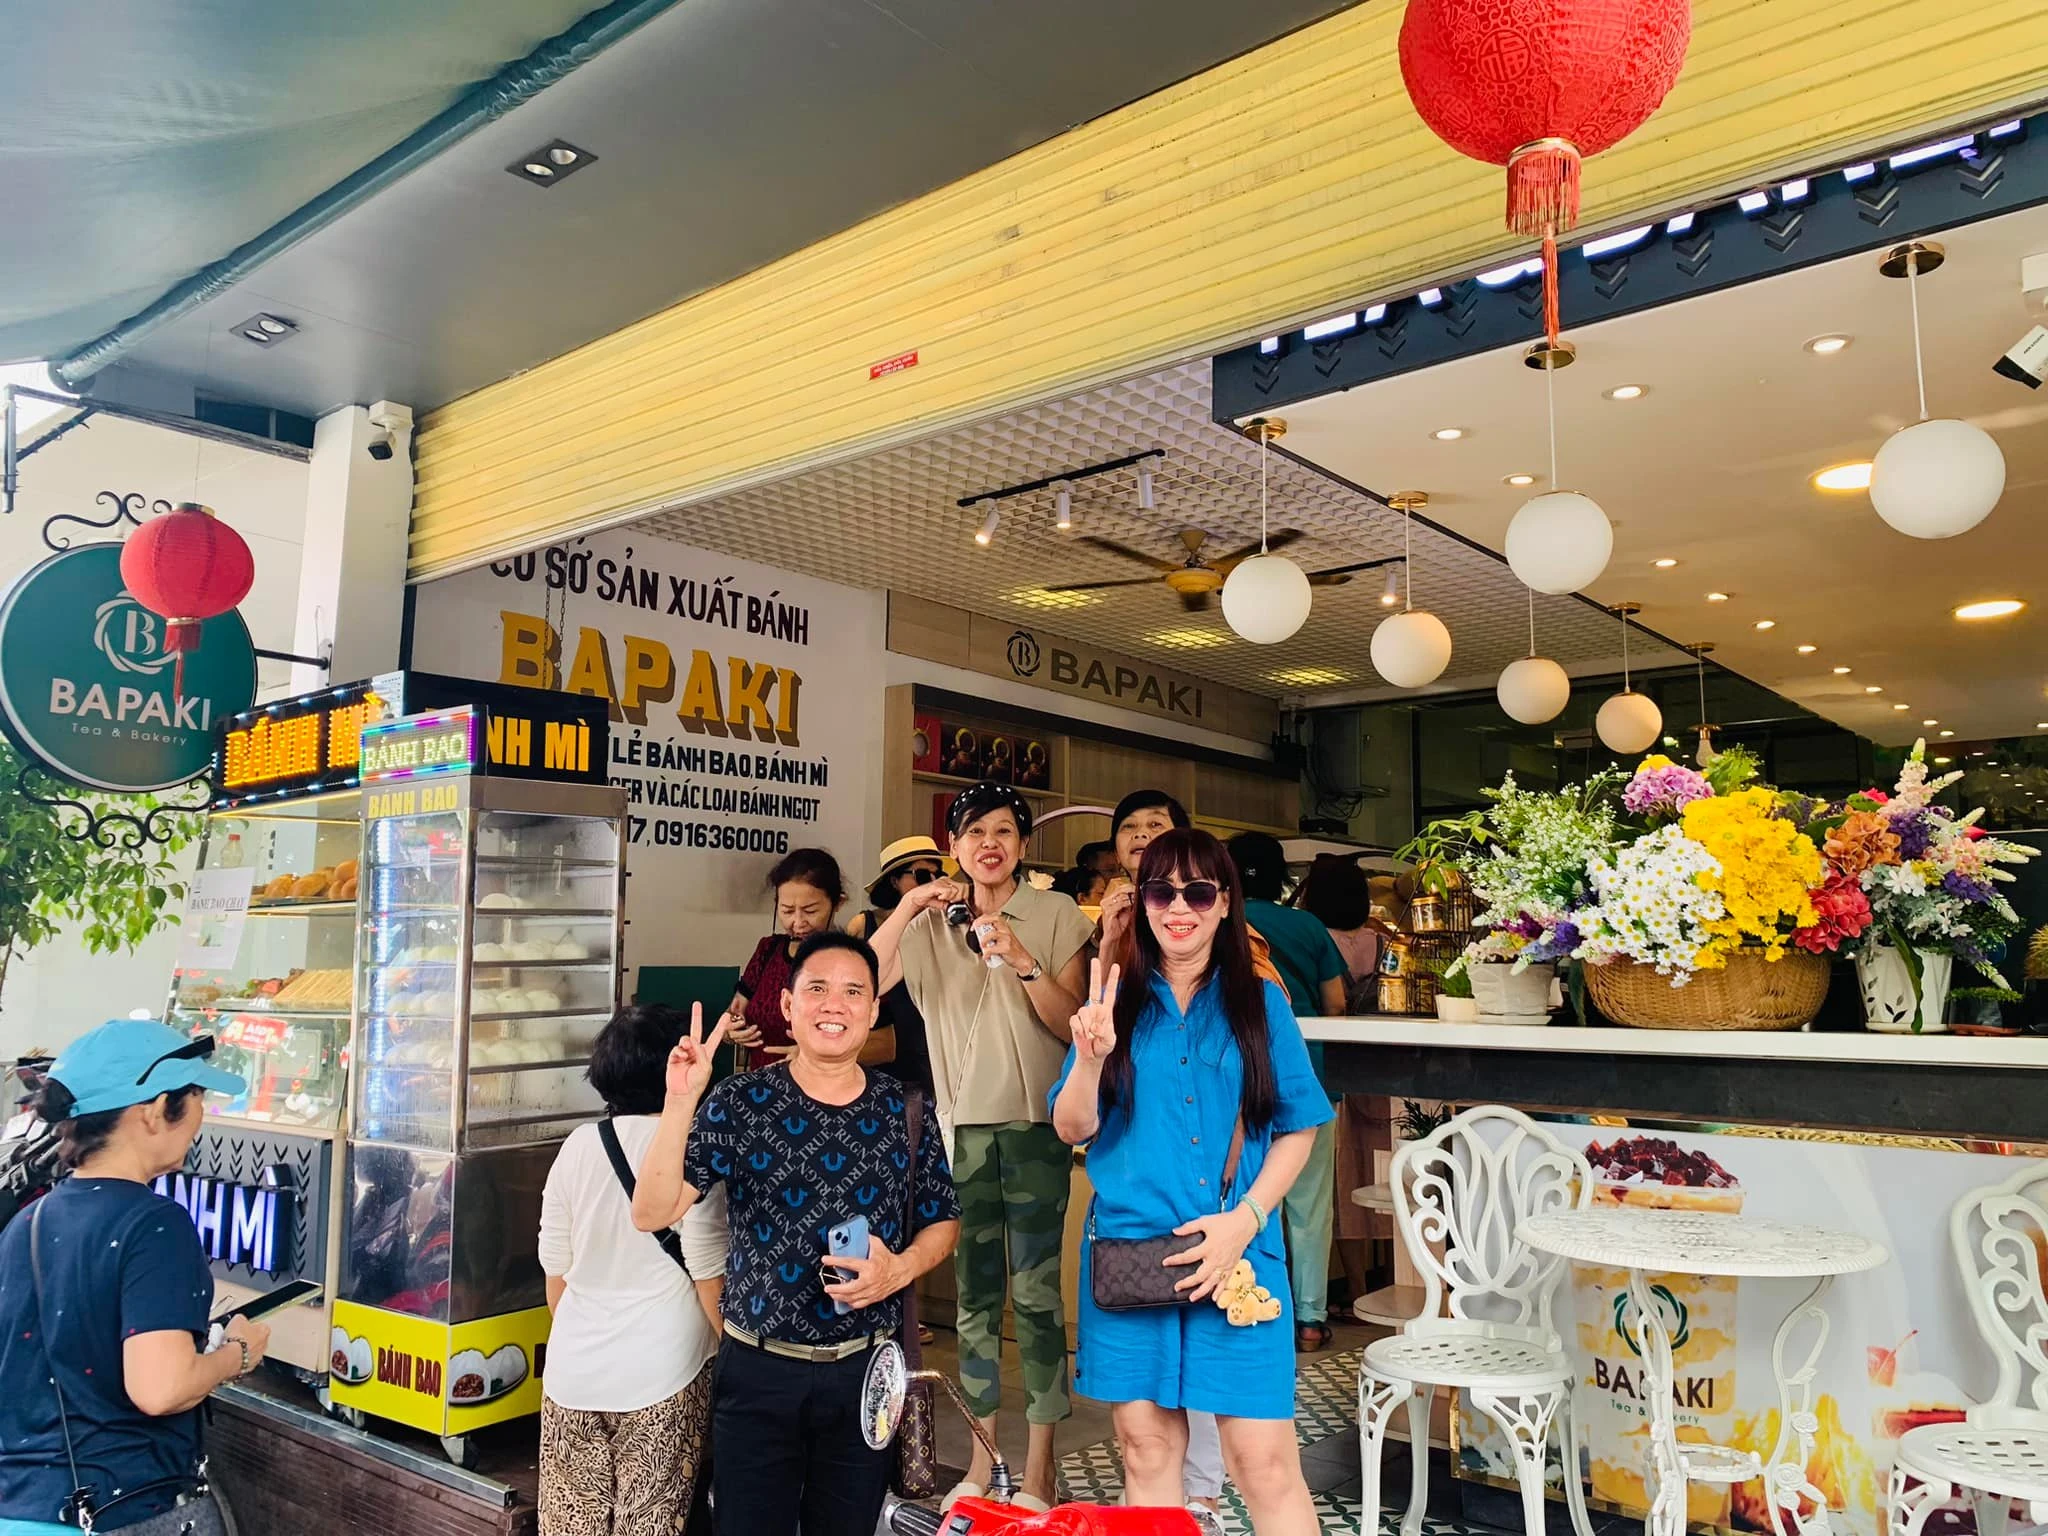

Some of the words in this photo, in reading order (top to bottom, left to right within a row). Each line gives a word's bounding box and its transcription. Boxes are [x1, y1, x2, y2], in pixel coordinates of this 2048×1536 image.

[597, 547, 659, 611] SẢN
[667, 576, 743, 629] XUẤT
[747, 590, 809, 645] BÁNH
[125, 610, 156, 655] B
[497, 611, 802, 747] BAPAKI
[1050, 648, 1204, 718] BAPAKI
[50, 678, 211, 731] BAPAKI
[71, 723, 102, 736] Tea
[112, 727, 121, 738] &
[131, 730, 187, 746] Bakery
[224, 717, 320, 786] BÁNH
[364, 736, 420, 771] BÁNH
[423, 733, 466, 764] BAO
[544, 717, 590, 772] MÌ
[612, 729, 641, 766] LẺ
[646, 737, 705, 773] BÁNH
[755, 750, 807, 785] BÁNH
[810, 756, 828, 787] MÌ
[368, 788, 415, 819] BÁNH
[421, 784, 458, 812] BAO
[702, 786, 737, 816] LOẠI
[740, 786, 779, 816] BÁNH
[782, 798, 820, 825] NGỌT
[654, 820, 788, 854] 0916360006
[727, 1072, 762, 1092] TRUE
[724, 1093, 761, 1127] RLGN
[760, 1093, 794, 1126] TRUE
[698, 1132, 737, 1148] TRUE
[761, 1126, 796, 1160] RLGN
[796, 1127, 834, 1161] TRUE
[834, 1127, 870, 1159] RLGN
[870, 1128, 901, 1159] TRUE
[761, 1159, 797, 1197] TRUE
[797, 1161, 833, 1197] RLGN
[832, 1159, 871, 1198] TRUE
[229, 1166, 278, 1272] MÌ
[761, 1198, 795, 1234] RLGN
[793, 1196, 832, 1235] TRUE
[761, 1233, 796, 1270] TRUE
[735, 1267, 762, 1300] TRUE
[761, 1271, 788, 1311] RLGN
[377, 1344, 412, 1389] BÁNH
[415, 1356, 442, 1399] BAO
[1611, 1398, 1631, 1413] Tea
[1638, 1406, 1646, 1416] &
